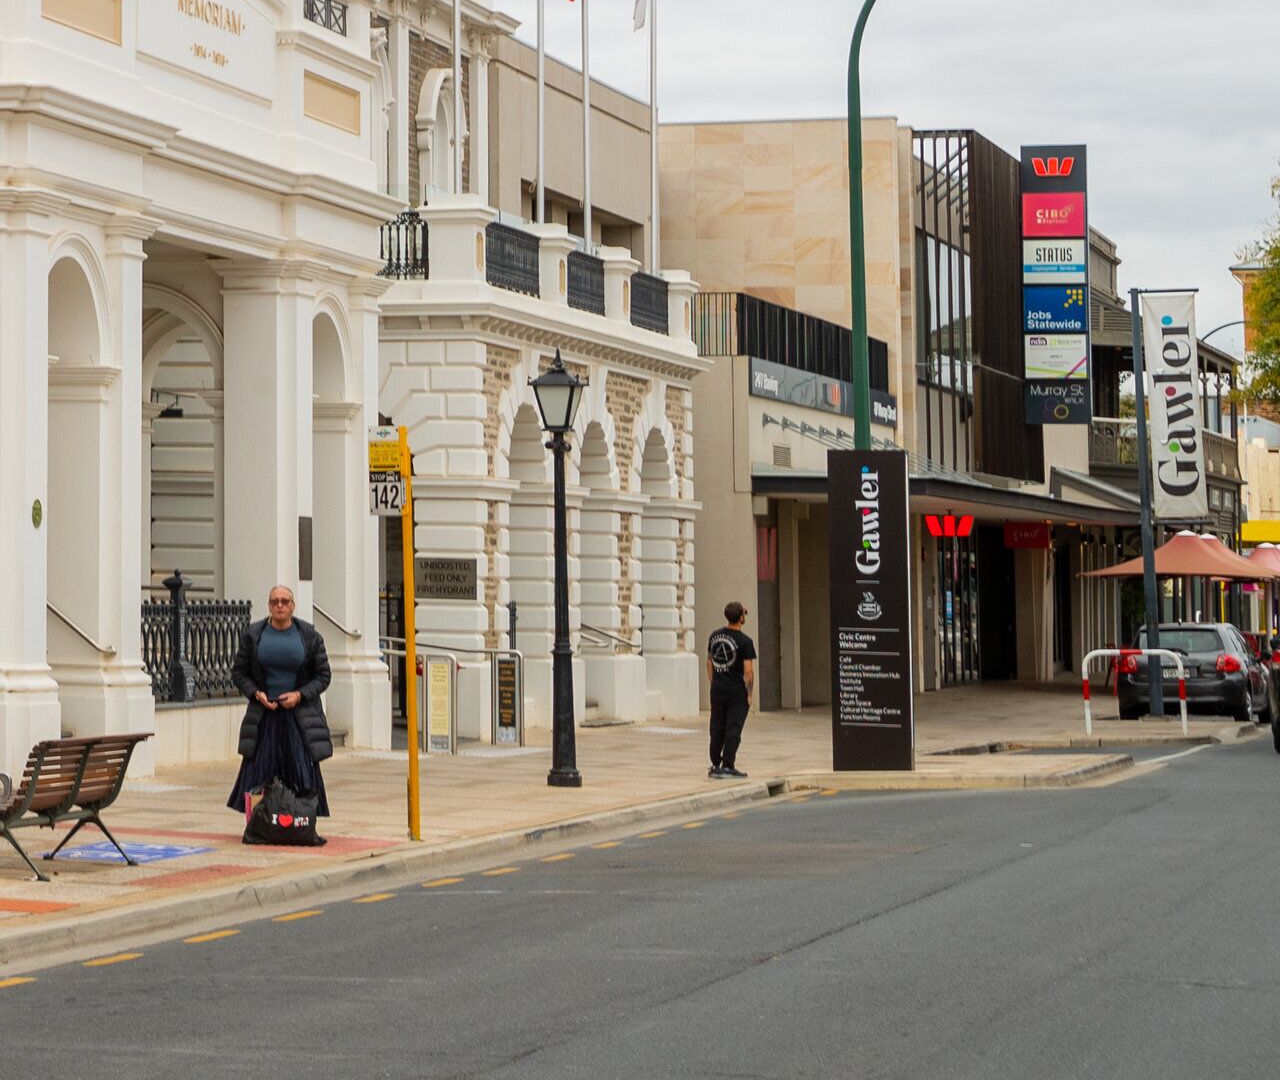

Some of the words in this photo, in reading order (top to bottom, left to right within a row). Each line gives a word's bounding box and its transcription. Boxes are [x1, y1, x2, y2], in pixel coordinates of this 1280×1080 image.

[1036, 208, 1069, 219] CIBO
[1035, 247, 1073, 263] STATUS
[1027, 310, 1052, 320] Jobs
[1027, 319, 1082, 330] Statewide
[1030, 384, 1067, 397] Murray
[1070, 384, 1083, 396] St
[1152, 315, 1200, 497] Gawler
[371, 485, 399, 509] 142
[855, 466, 880, 575] Gawler
[424, 573, 445, 582] FEED
[446, 573, 468, 583] ONLY
[416, 585, 433, 593] FIRE
[434, 586, 475, 595] HYDRANT
[839, 632, 855, 641] Civic
[855, 633, 876, 642] Centre
[839, 641, 868, 650] Welcome
